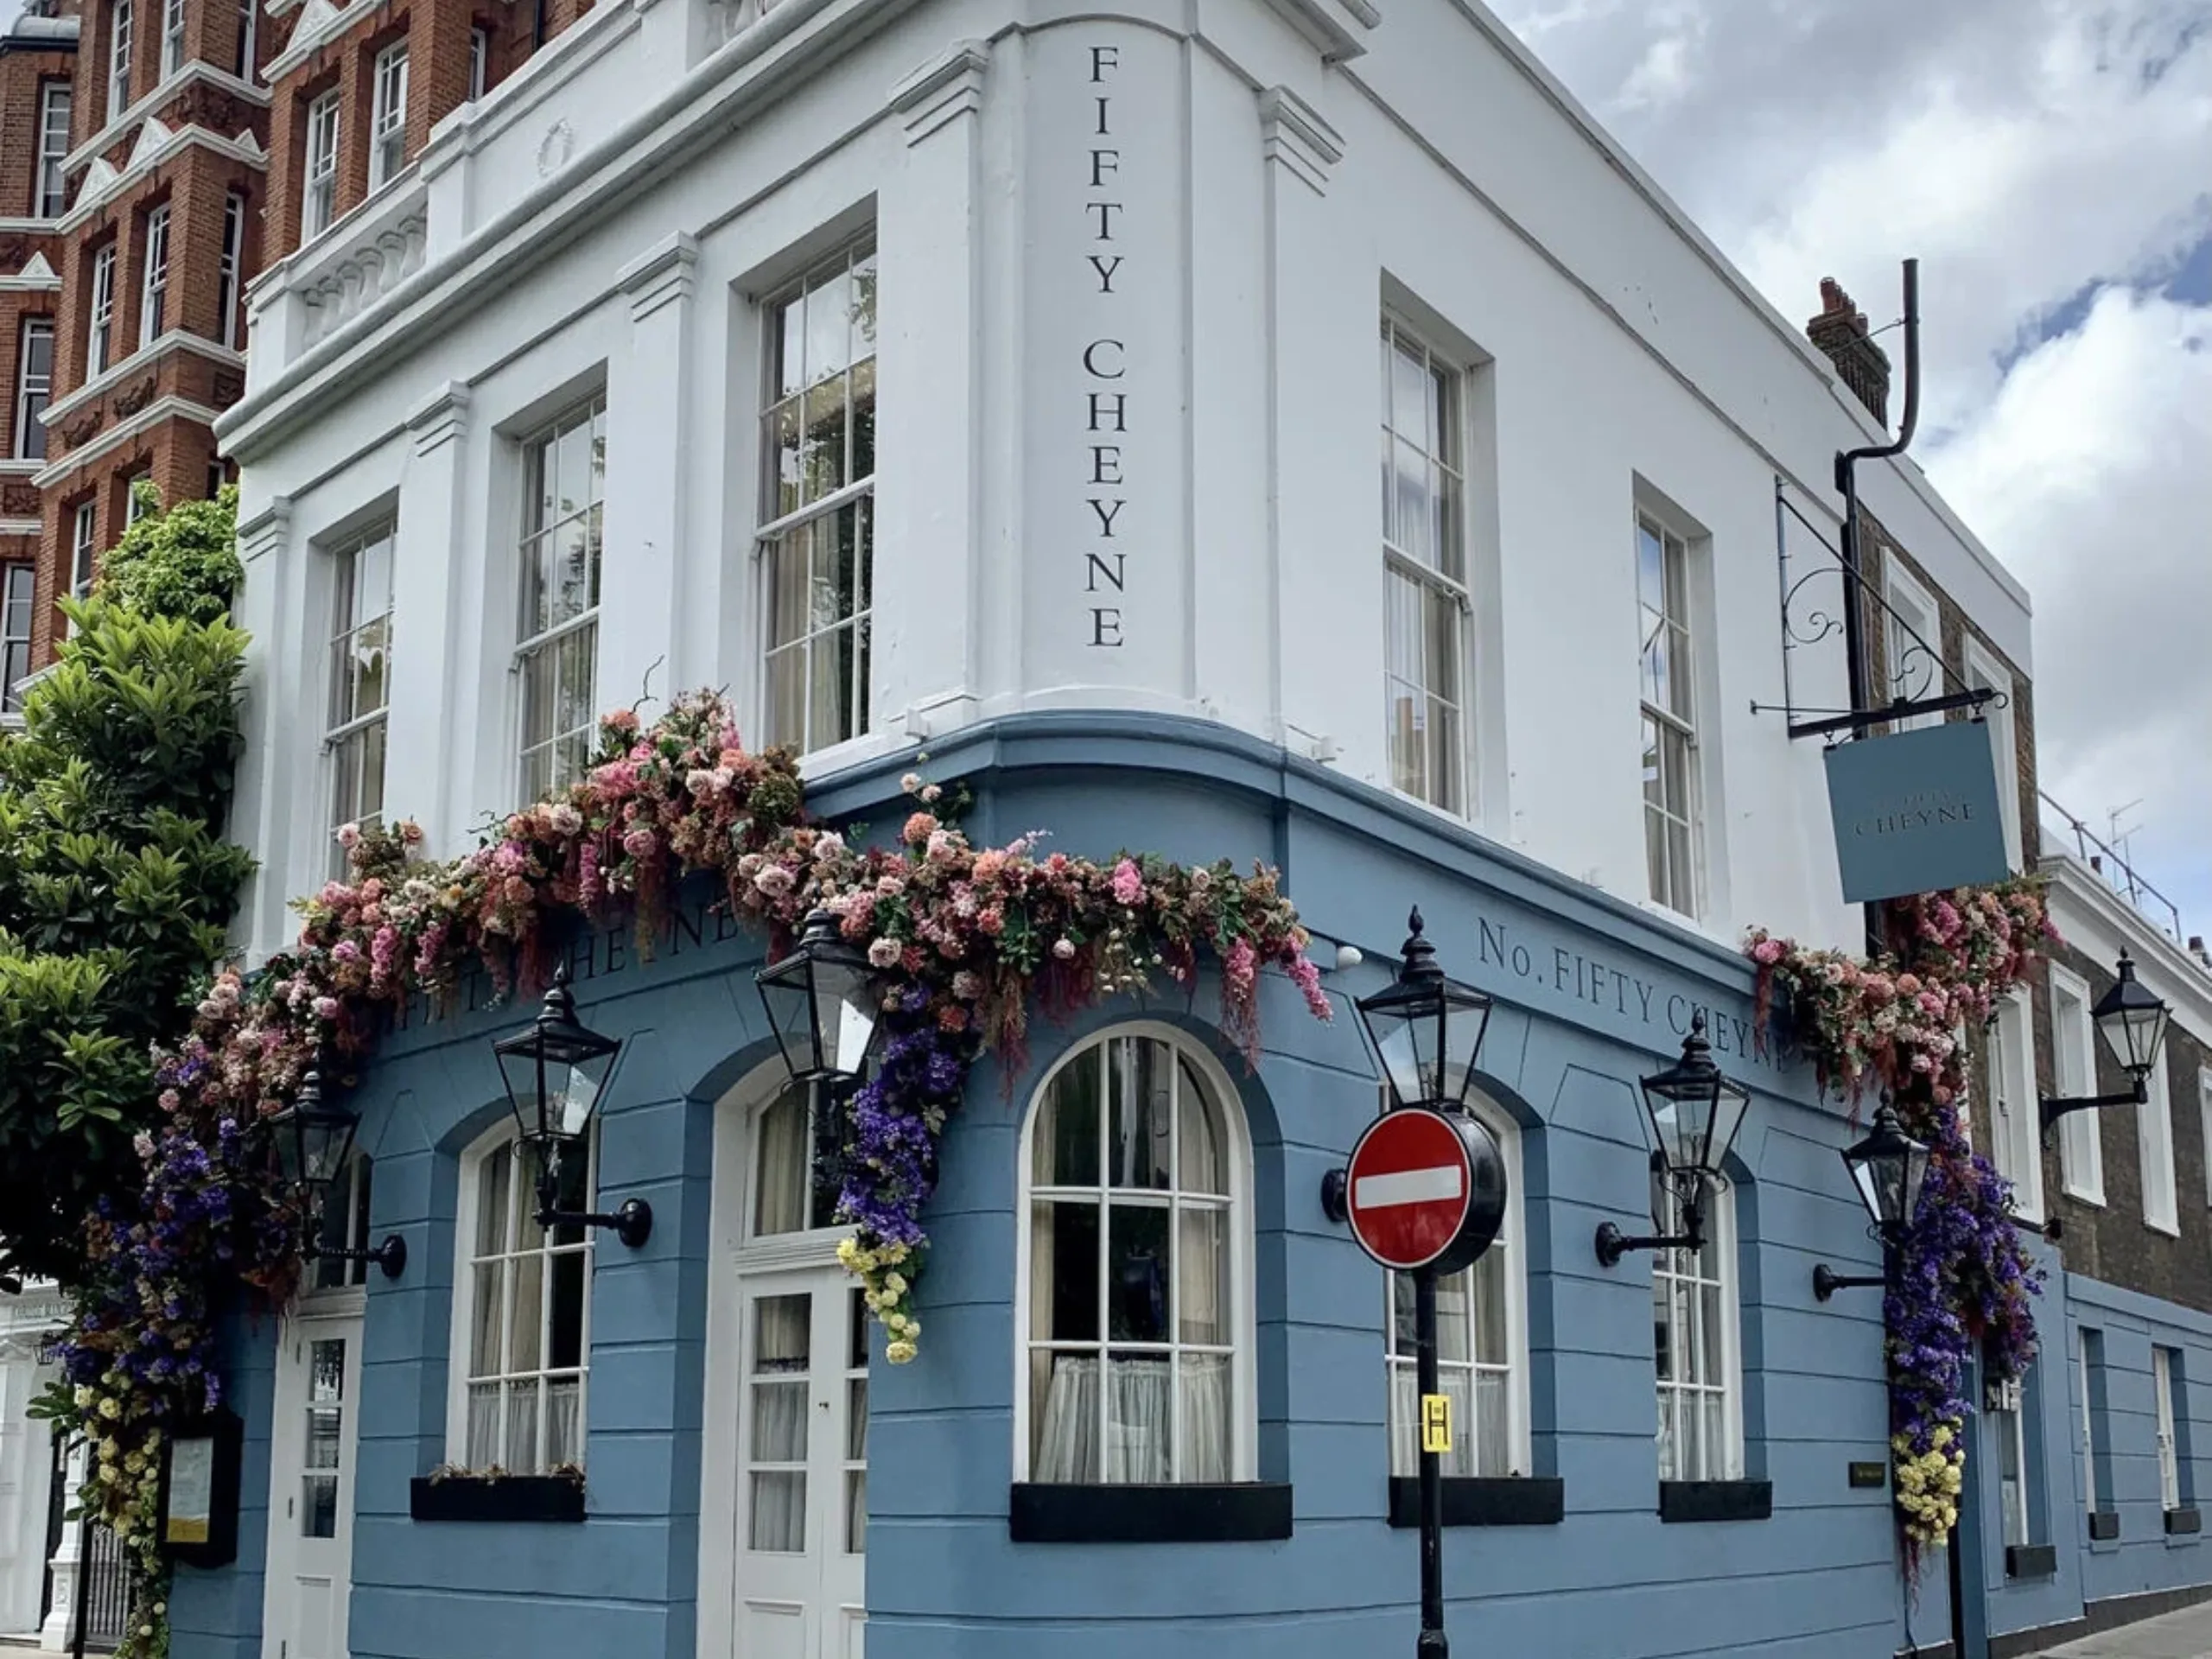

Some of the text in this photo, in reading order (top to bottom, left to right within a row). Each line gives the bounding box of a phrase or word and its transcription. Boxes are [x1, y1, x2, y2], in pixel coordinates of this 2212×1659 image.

[1083, 47, 1127, 647] FIFTY CHEYNE
[1852, 801, 1976, 839] CHEYNE
[1478, 916, 1542, 984] No.
[1554, 946, 1656, 1024] FIFTY
[1427, 1401, 1447, 1445] H
